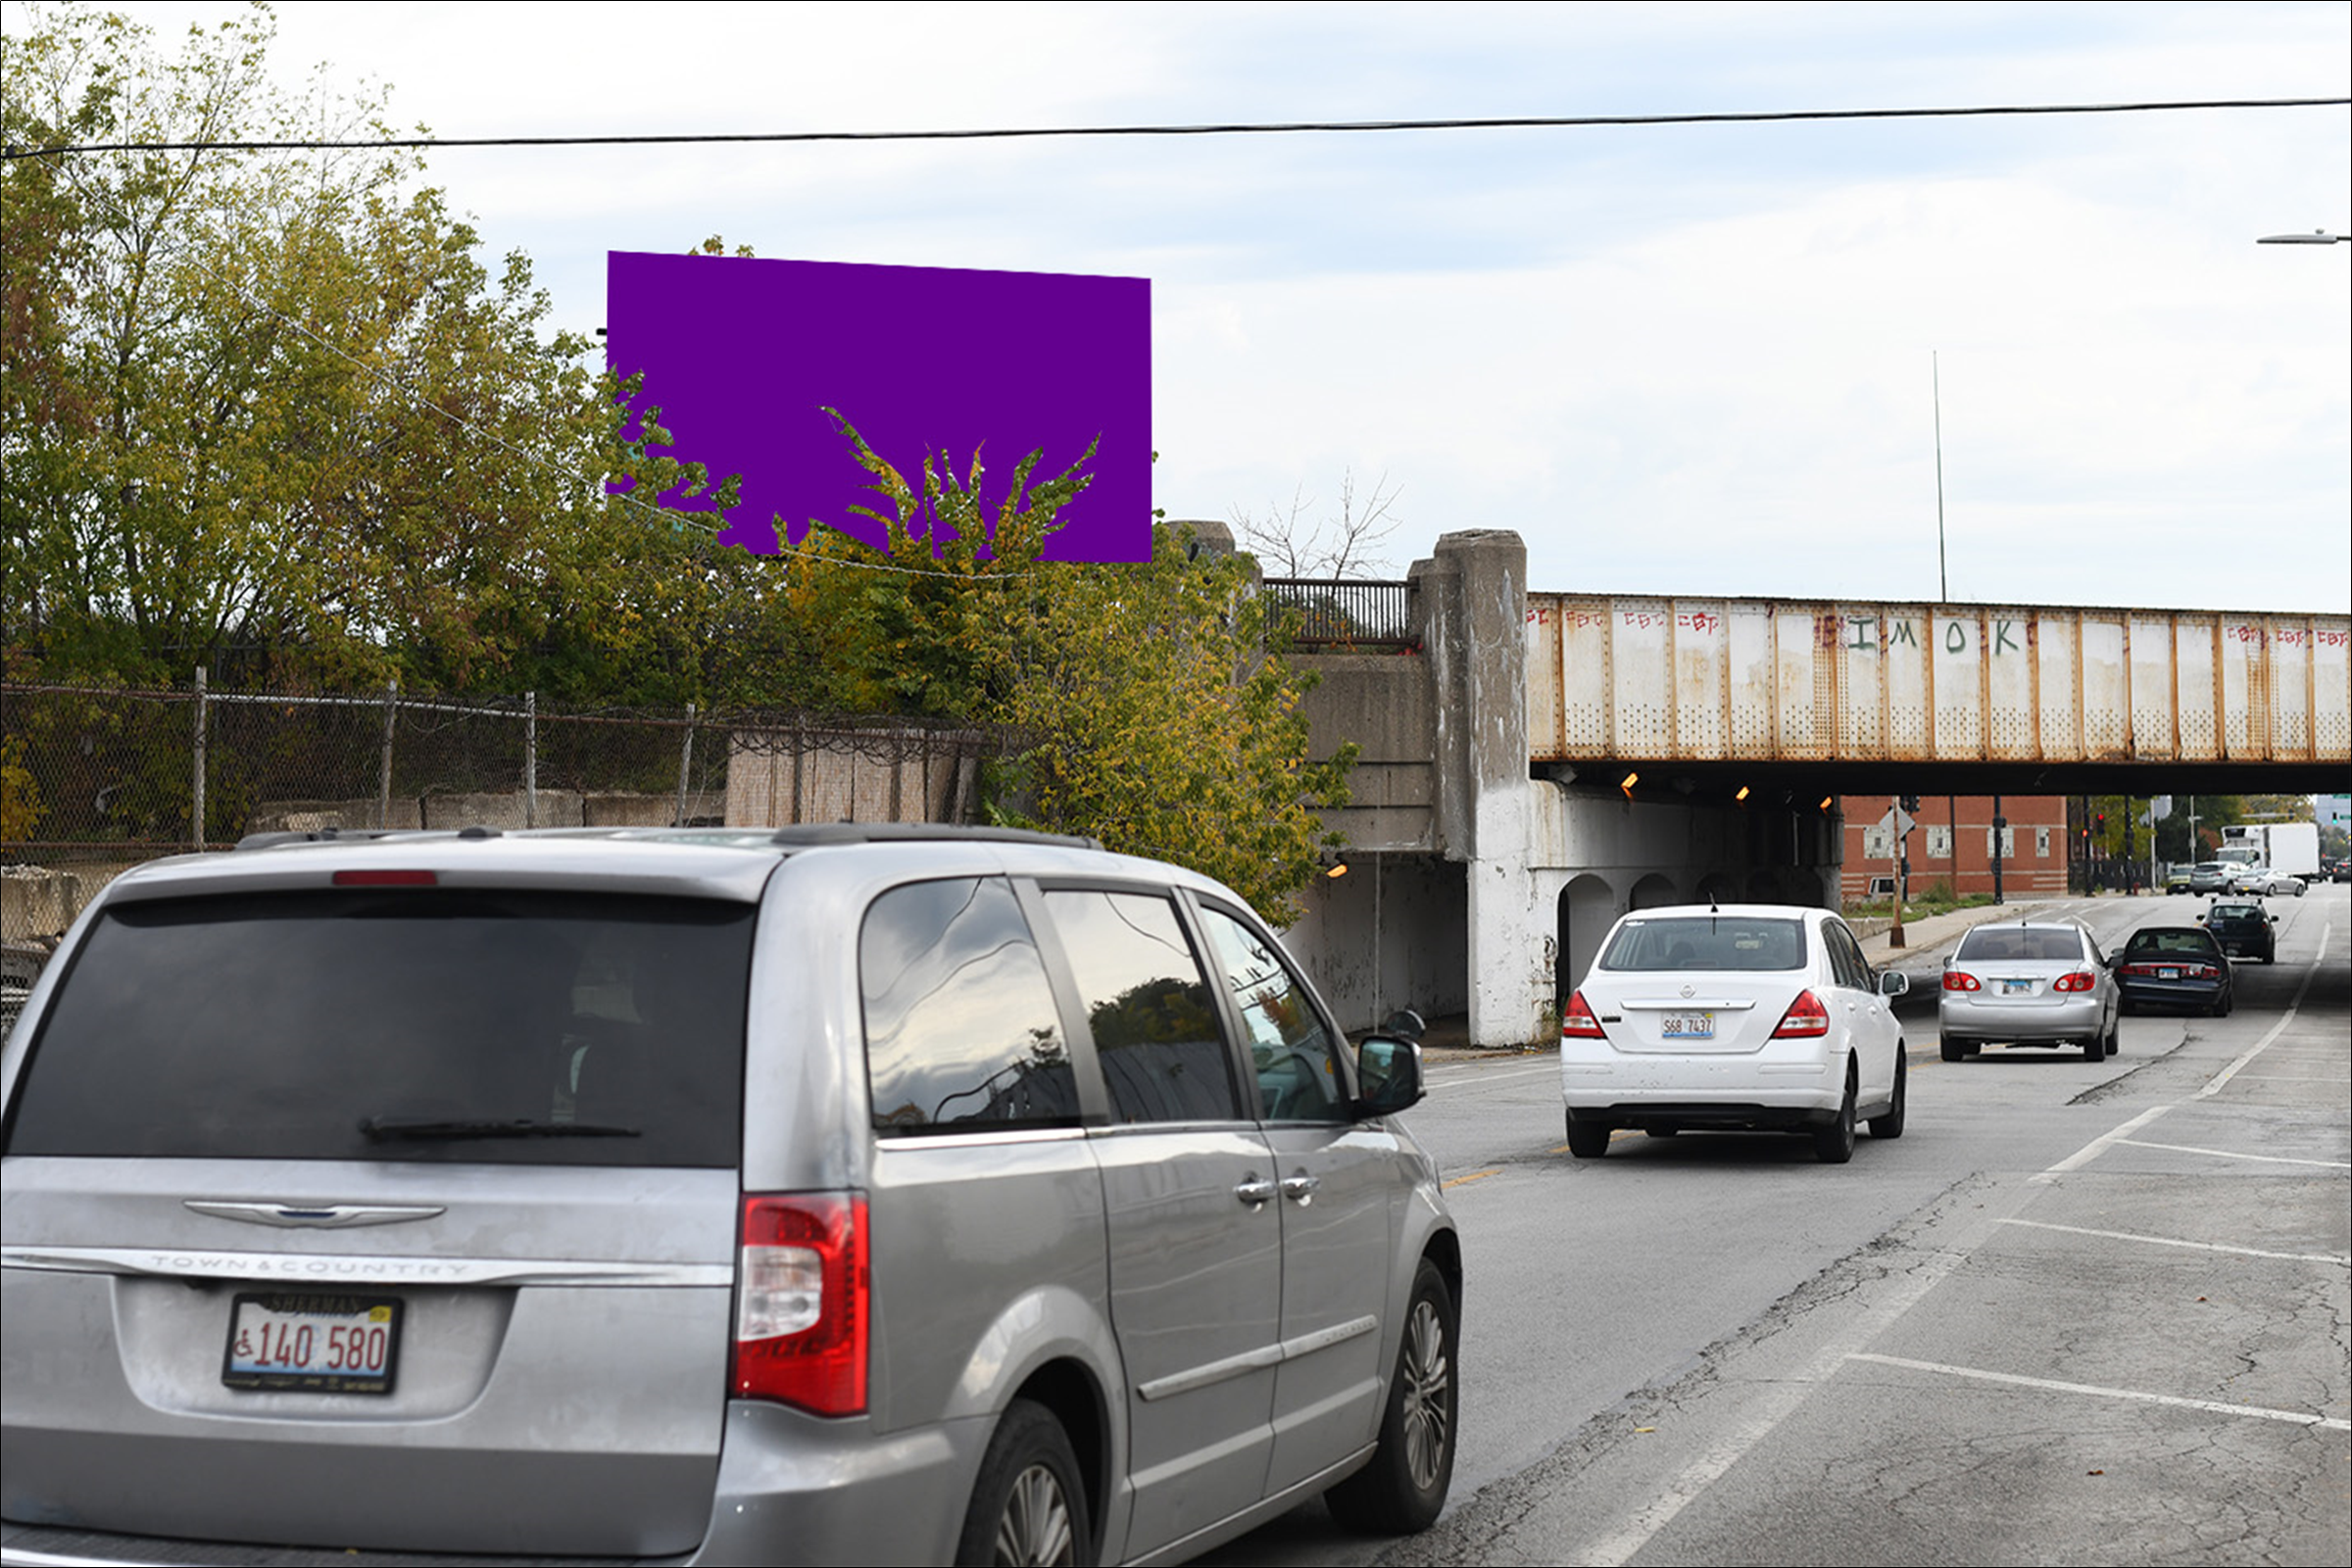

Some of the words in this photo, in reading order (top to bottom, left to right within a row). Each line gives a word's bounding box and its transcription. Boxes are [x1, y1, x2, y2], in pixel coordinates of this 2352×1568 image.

[1688, 1018, 1712, 1033] 7437
[254, 1322, 313, 1368] 140
[327, 1325, 386, 1371] 580
